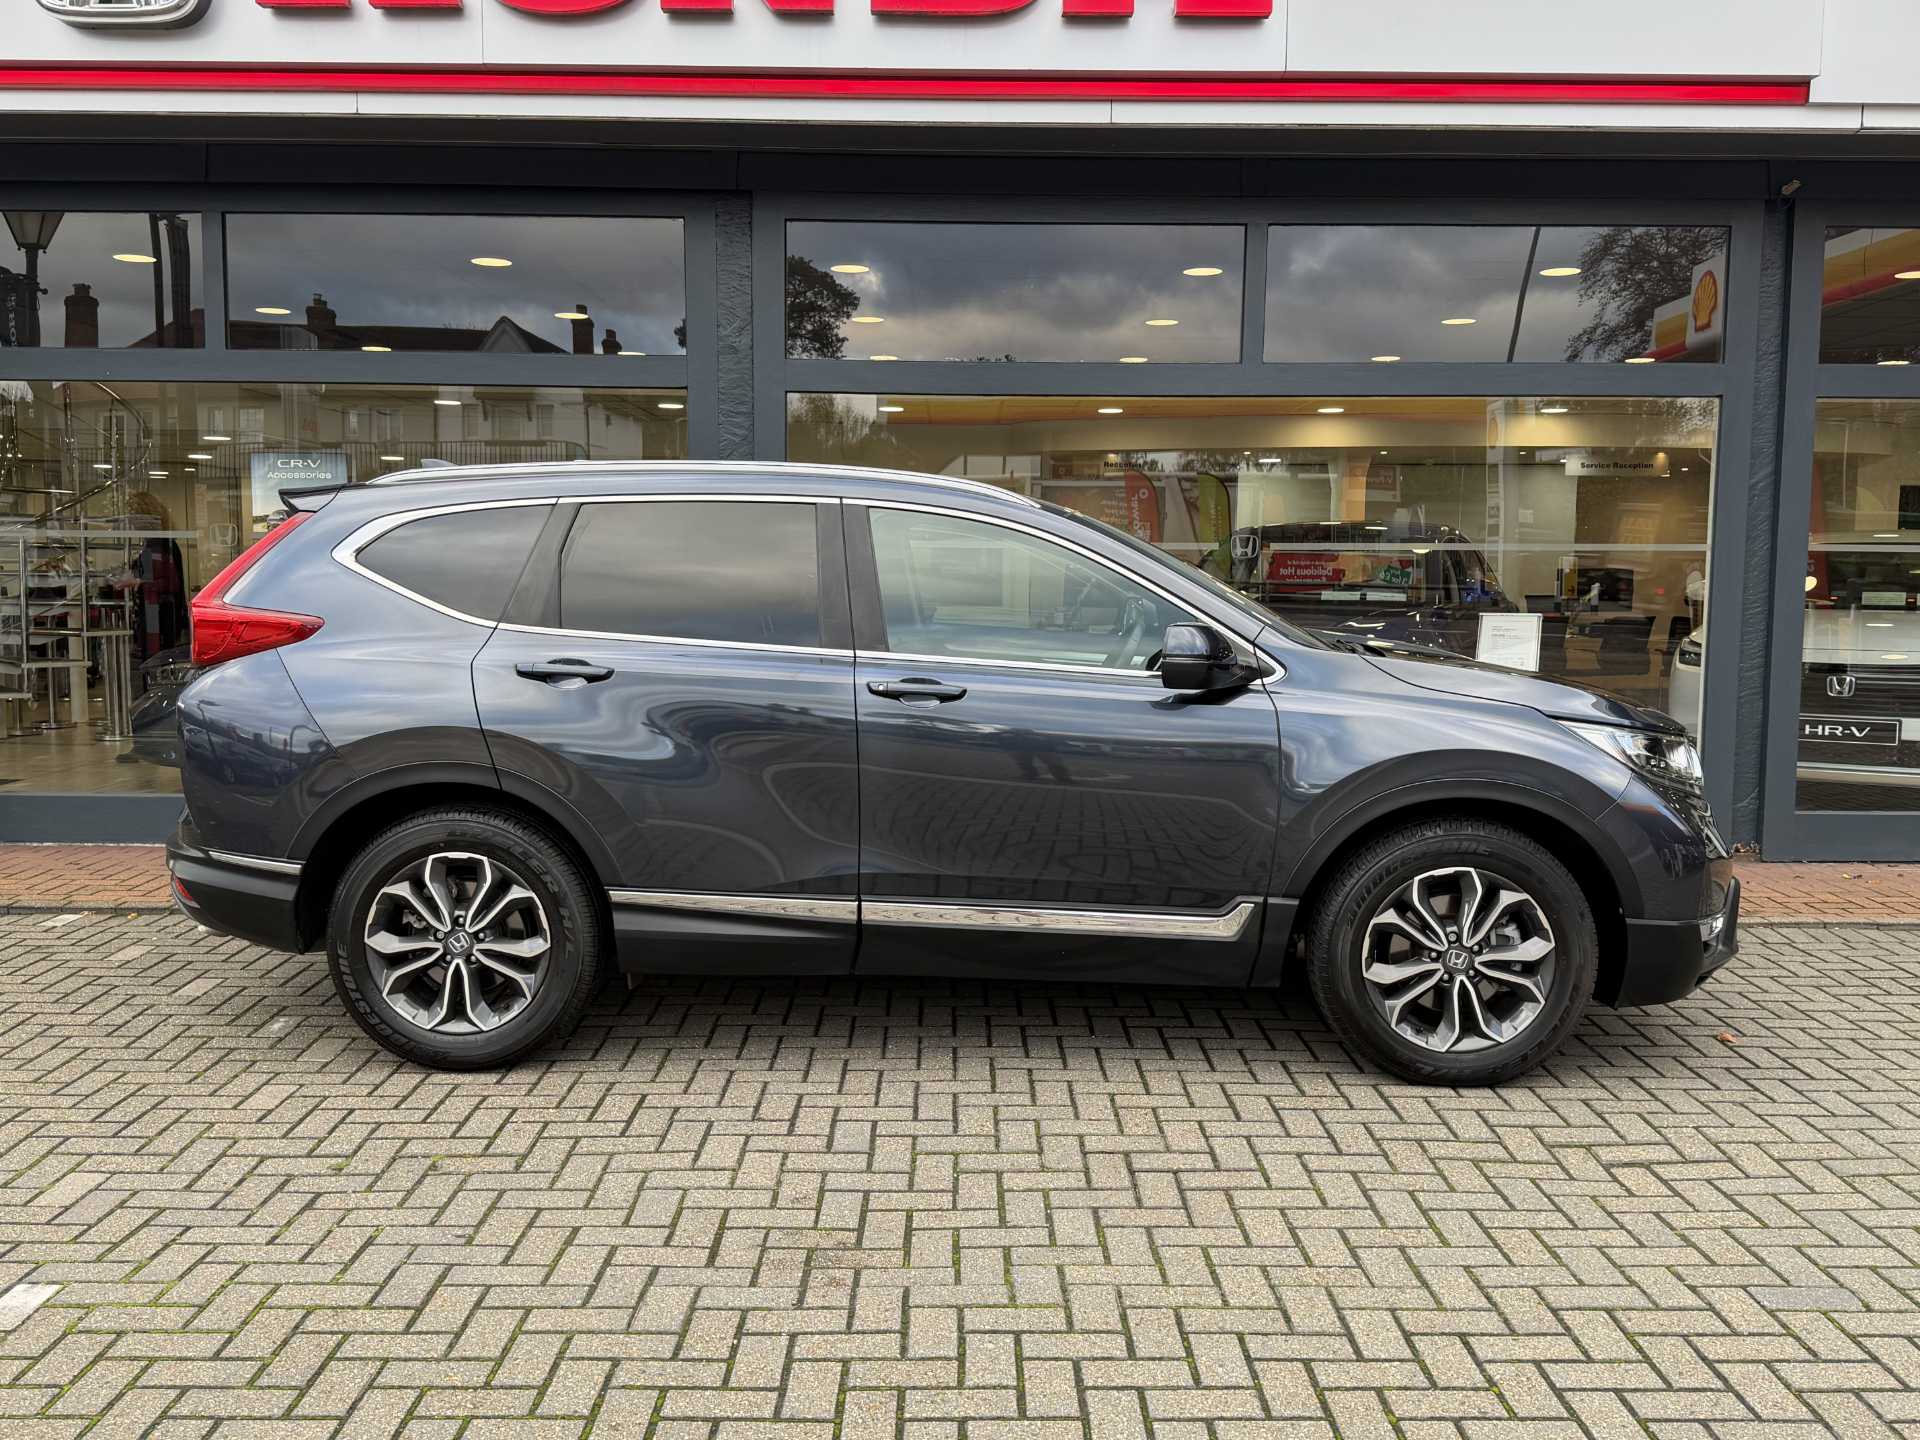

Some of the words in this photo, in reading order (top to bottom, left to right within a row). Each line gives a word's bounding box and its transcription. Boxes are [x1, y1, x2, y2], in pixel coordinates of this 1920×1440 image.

[277, 459, 321, 468] CR-V
[1612, 462, 1654, 470] Reception
[267, 471, 332, 479] Accessories
[1804, 724, 1871, 737] HR-V
